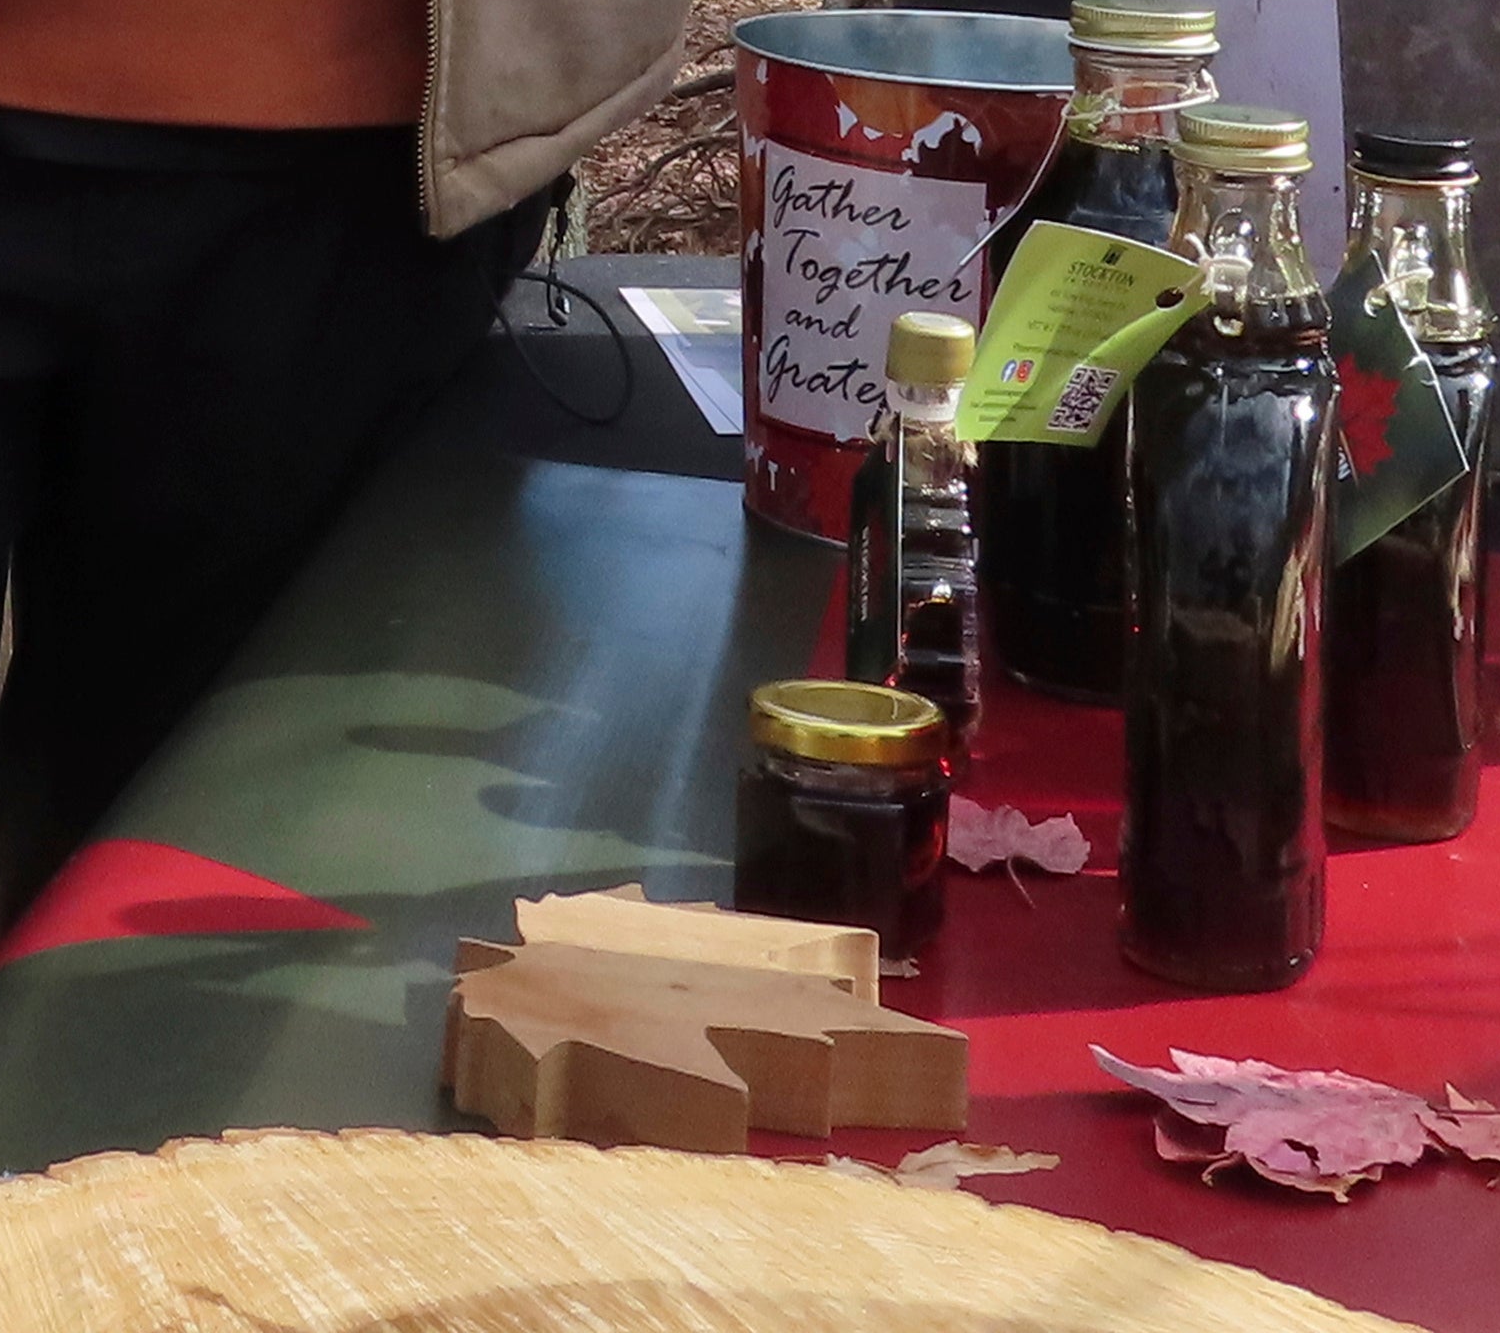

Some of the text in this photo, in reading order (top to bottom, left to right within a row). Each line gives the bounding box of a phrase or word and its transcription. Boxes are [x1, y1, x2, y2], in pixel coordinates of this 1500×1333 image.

[771, 165, 911, 231] Gather
[782, 229, 973, 304] Together
[1067, 260, 1136, 287] STOCKTON
[785, 304, 862, 339] and
[766, 334, 890, 421] Grate
